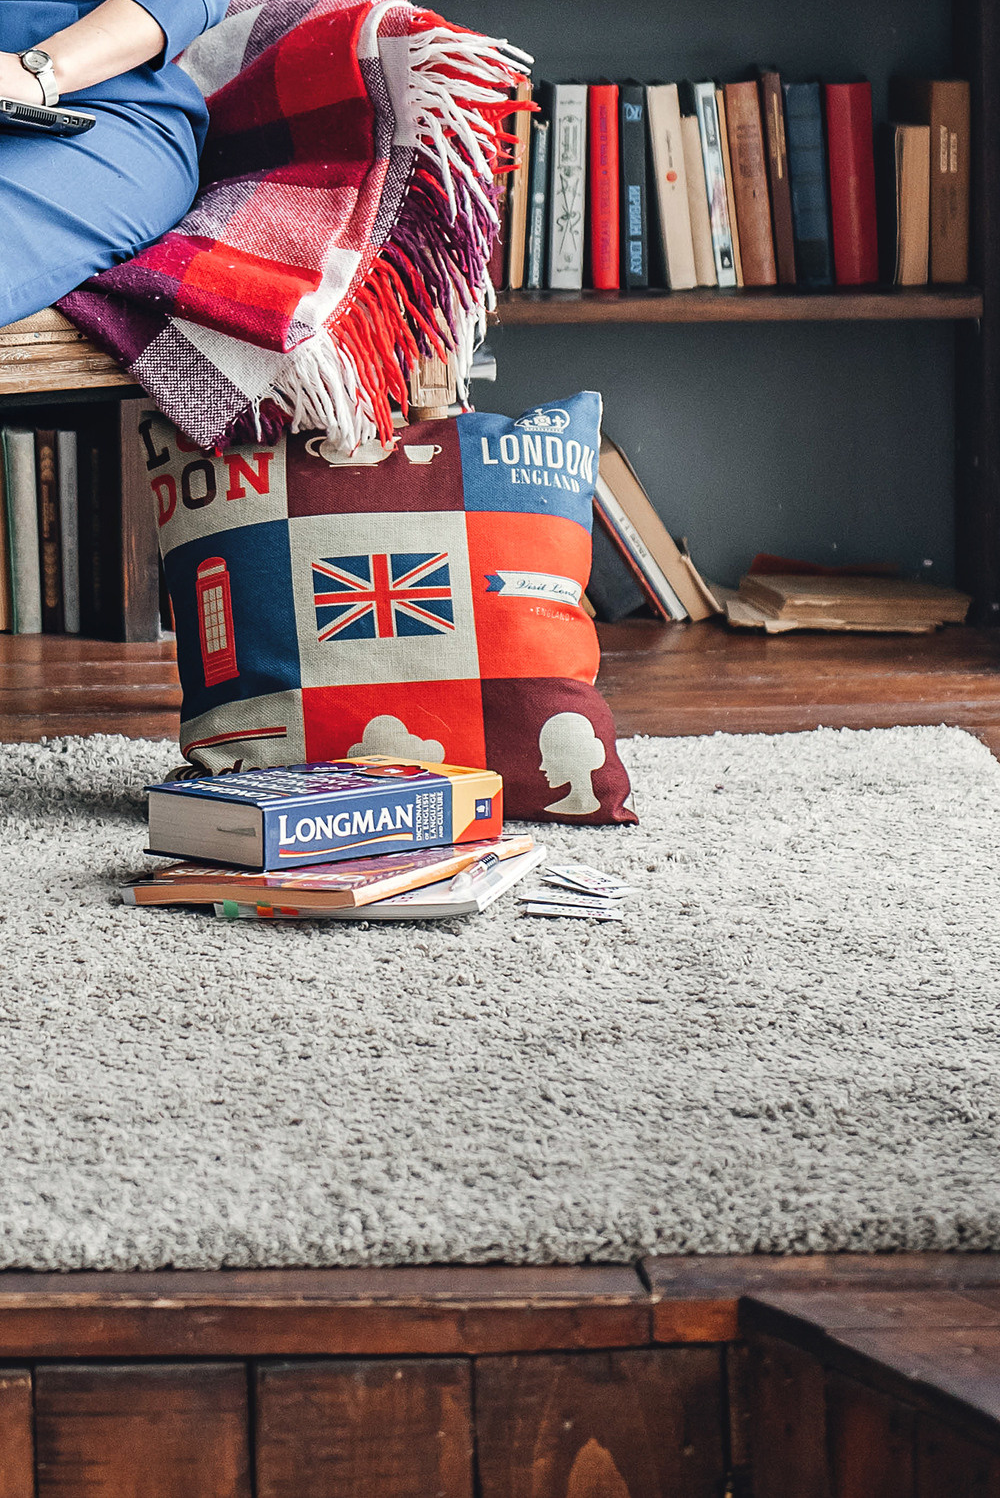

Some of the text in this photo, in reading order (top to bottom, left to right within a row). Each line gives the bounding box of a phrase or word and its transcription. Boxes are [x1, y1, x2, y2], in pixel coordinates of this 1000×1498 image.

[481, 434, 595, 484] LONDON
[151, 451, 275, 528] DON
[511, 468, 580, 493] ENGLAND
[515, 578, 547, 594] Visit
[278, 804, 415, 846] LONGMAN
